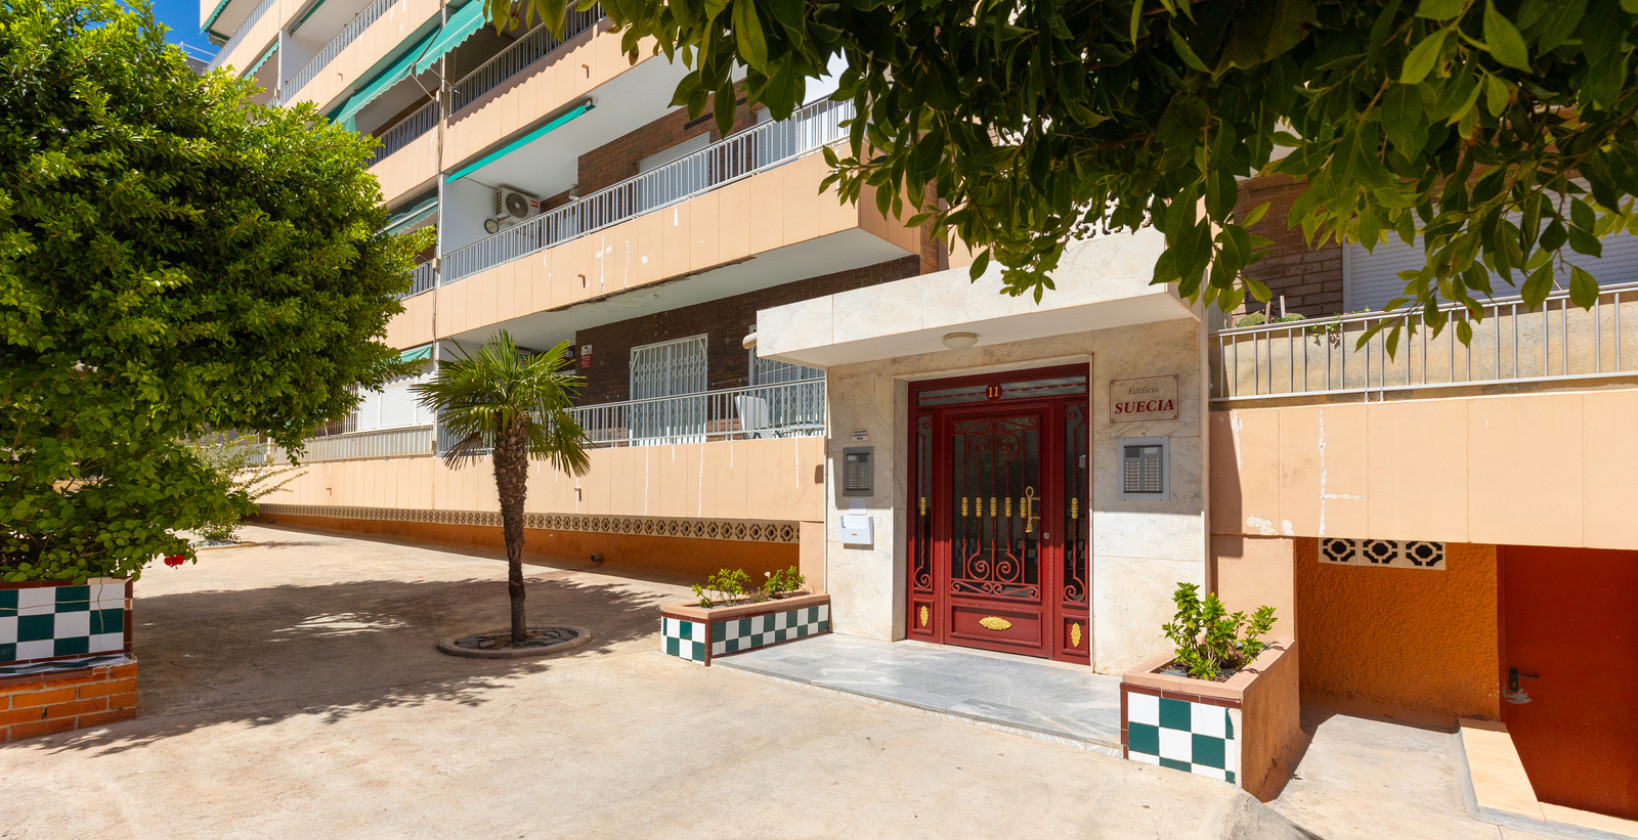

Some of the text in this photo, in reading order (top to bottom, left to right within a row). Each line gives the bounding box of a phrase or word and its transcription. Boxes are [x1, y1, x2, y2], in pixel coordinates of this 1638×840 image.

[988, 386, 999, 398] 11
[1128, 385, 1159, 395] Edificio
[1114, 399, 1174, 414] SUECIA
